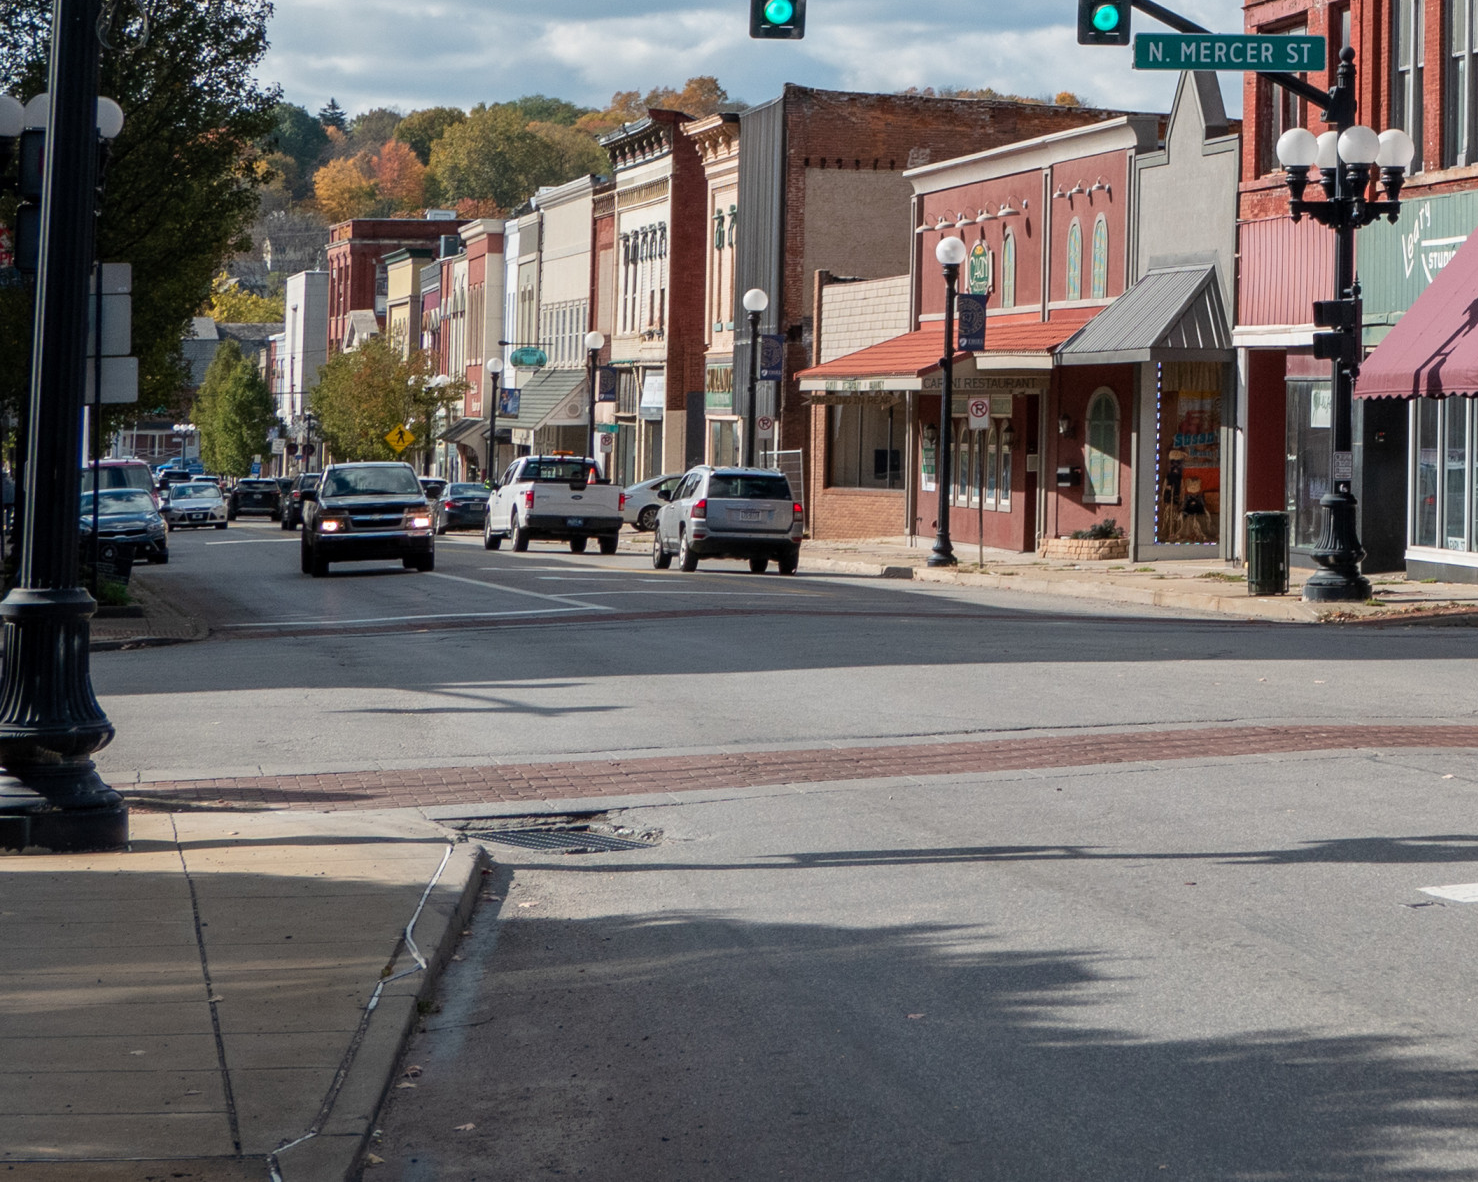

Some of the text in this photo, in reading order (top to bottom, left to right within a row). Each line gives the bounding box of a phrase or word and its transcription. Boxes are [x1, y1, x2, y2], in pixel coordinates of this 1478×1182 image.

[1149, 42, 1312, 64] N. MERCER ST
[1402, 201, 1431, 279] Leary
[964, 378, 1037, 389] RESTAURANT
